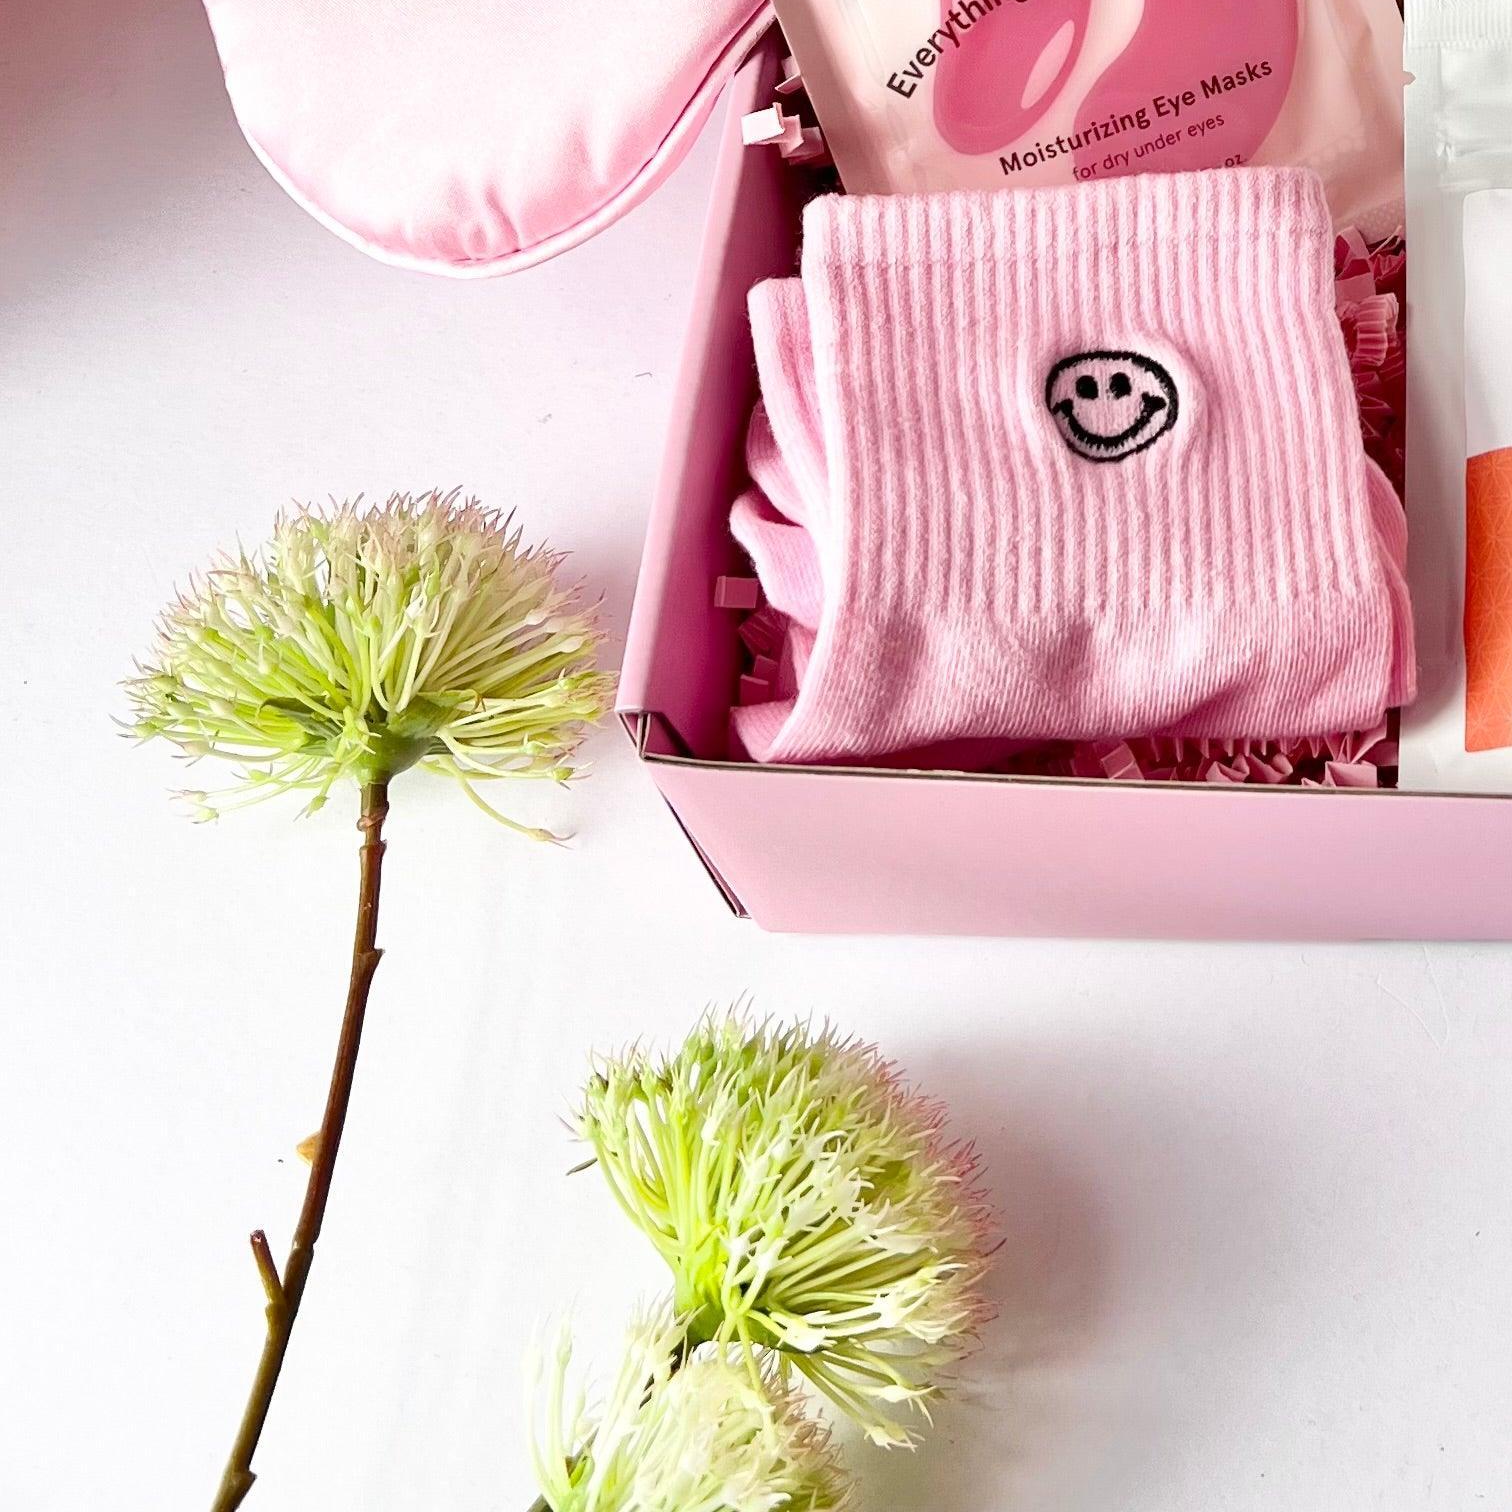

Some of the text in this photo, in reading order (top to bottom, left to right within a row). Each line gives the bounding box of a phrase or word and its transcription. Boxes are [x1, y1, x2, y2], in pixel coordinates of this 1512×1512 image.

[999, 60, 1273, 175] Moisturizing Eye Masks
[1072, 113, 1225, 181] for dry under eyes
